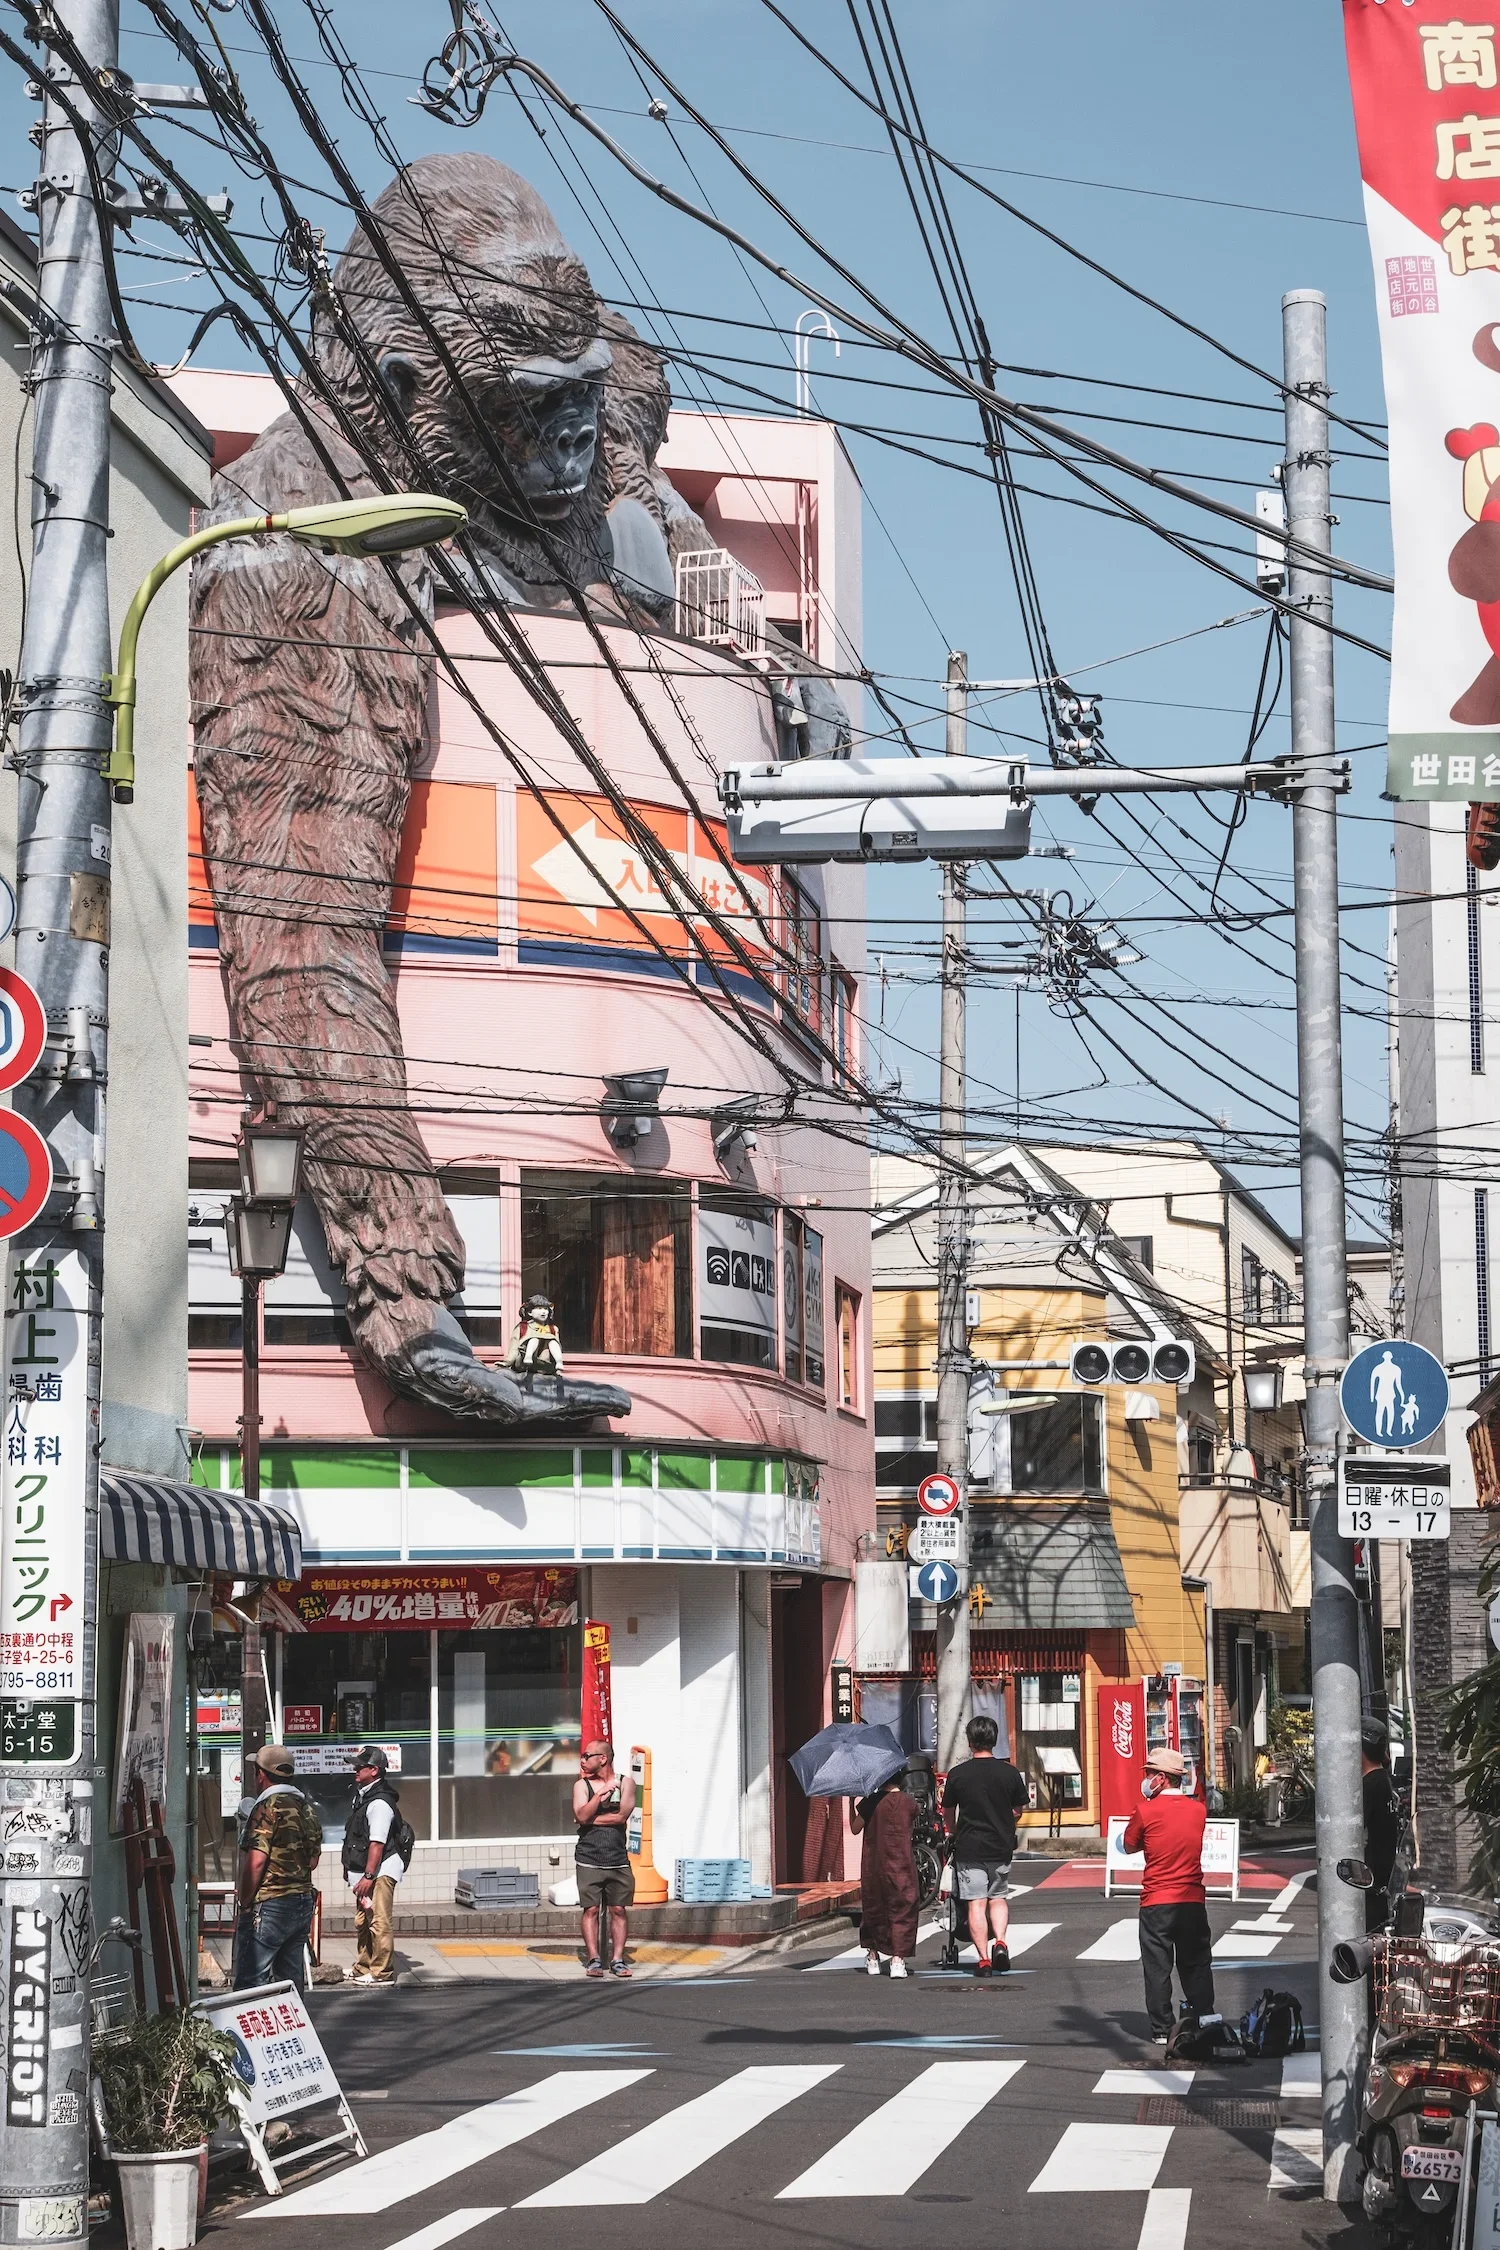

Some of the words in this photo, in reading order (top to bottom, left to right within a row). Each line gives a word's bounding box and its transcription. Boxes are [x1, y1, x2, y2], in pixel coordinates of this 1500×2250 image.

[12, 1258, 60, 1365] 村上
[805, 1294, 822, 1326] GYM
[1346, 1486, 1444, 1507] 日曜・休日の
[1351, 1511, 1372, 1531] 13
[1416, 1512, 1437, 1532] 17
[12, 1474, 49, 1622] クリニック
[329, 1592, 466, 1622] 40%増量
[838, 1672, 851, 1717] 営業中
[3, 1711, 57, 1730] 太子堂
[1113, 1698, 1133, 1759] Coca-Cola
[4, 1735, 54, 1753] 5-15
[236, 2001, 306, 2042] 車両進入禁止
